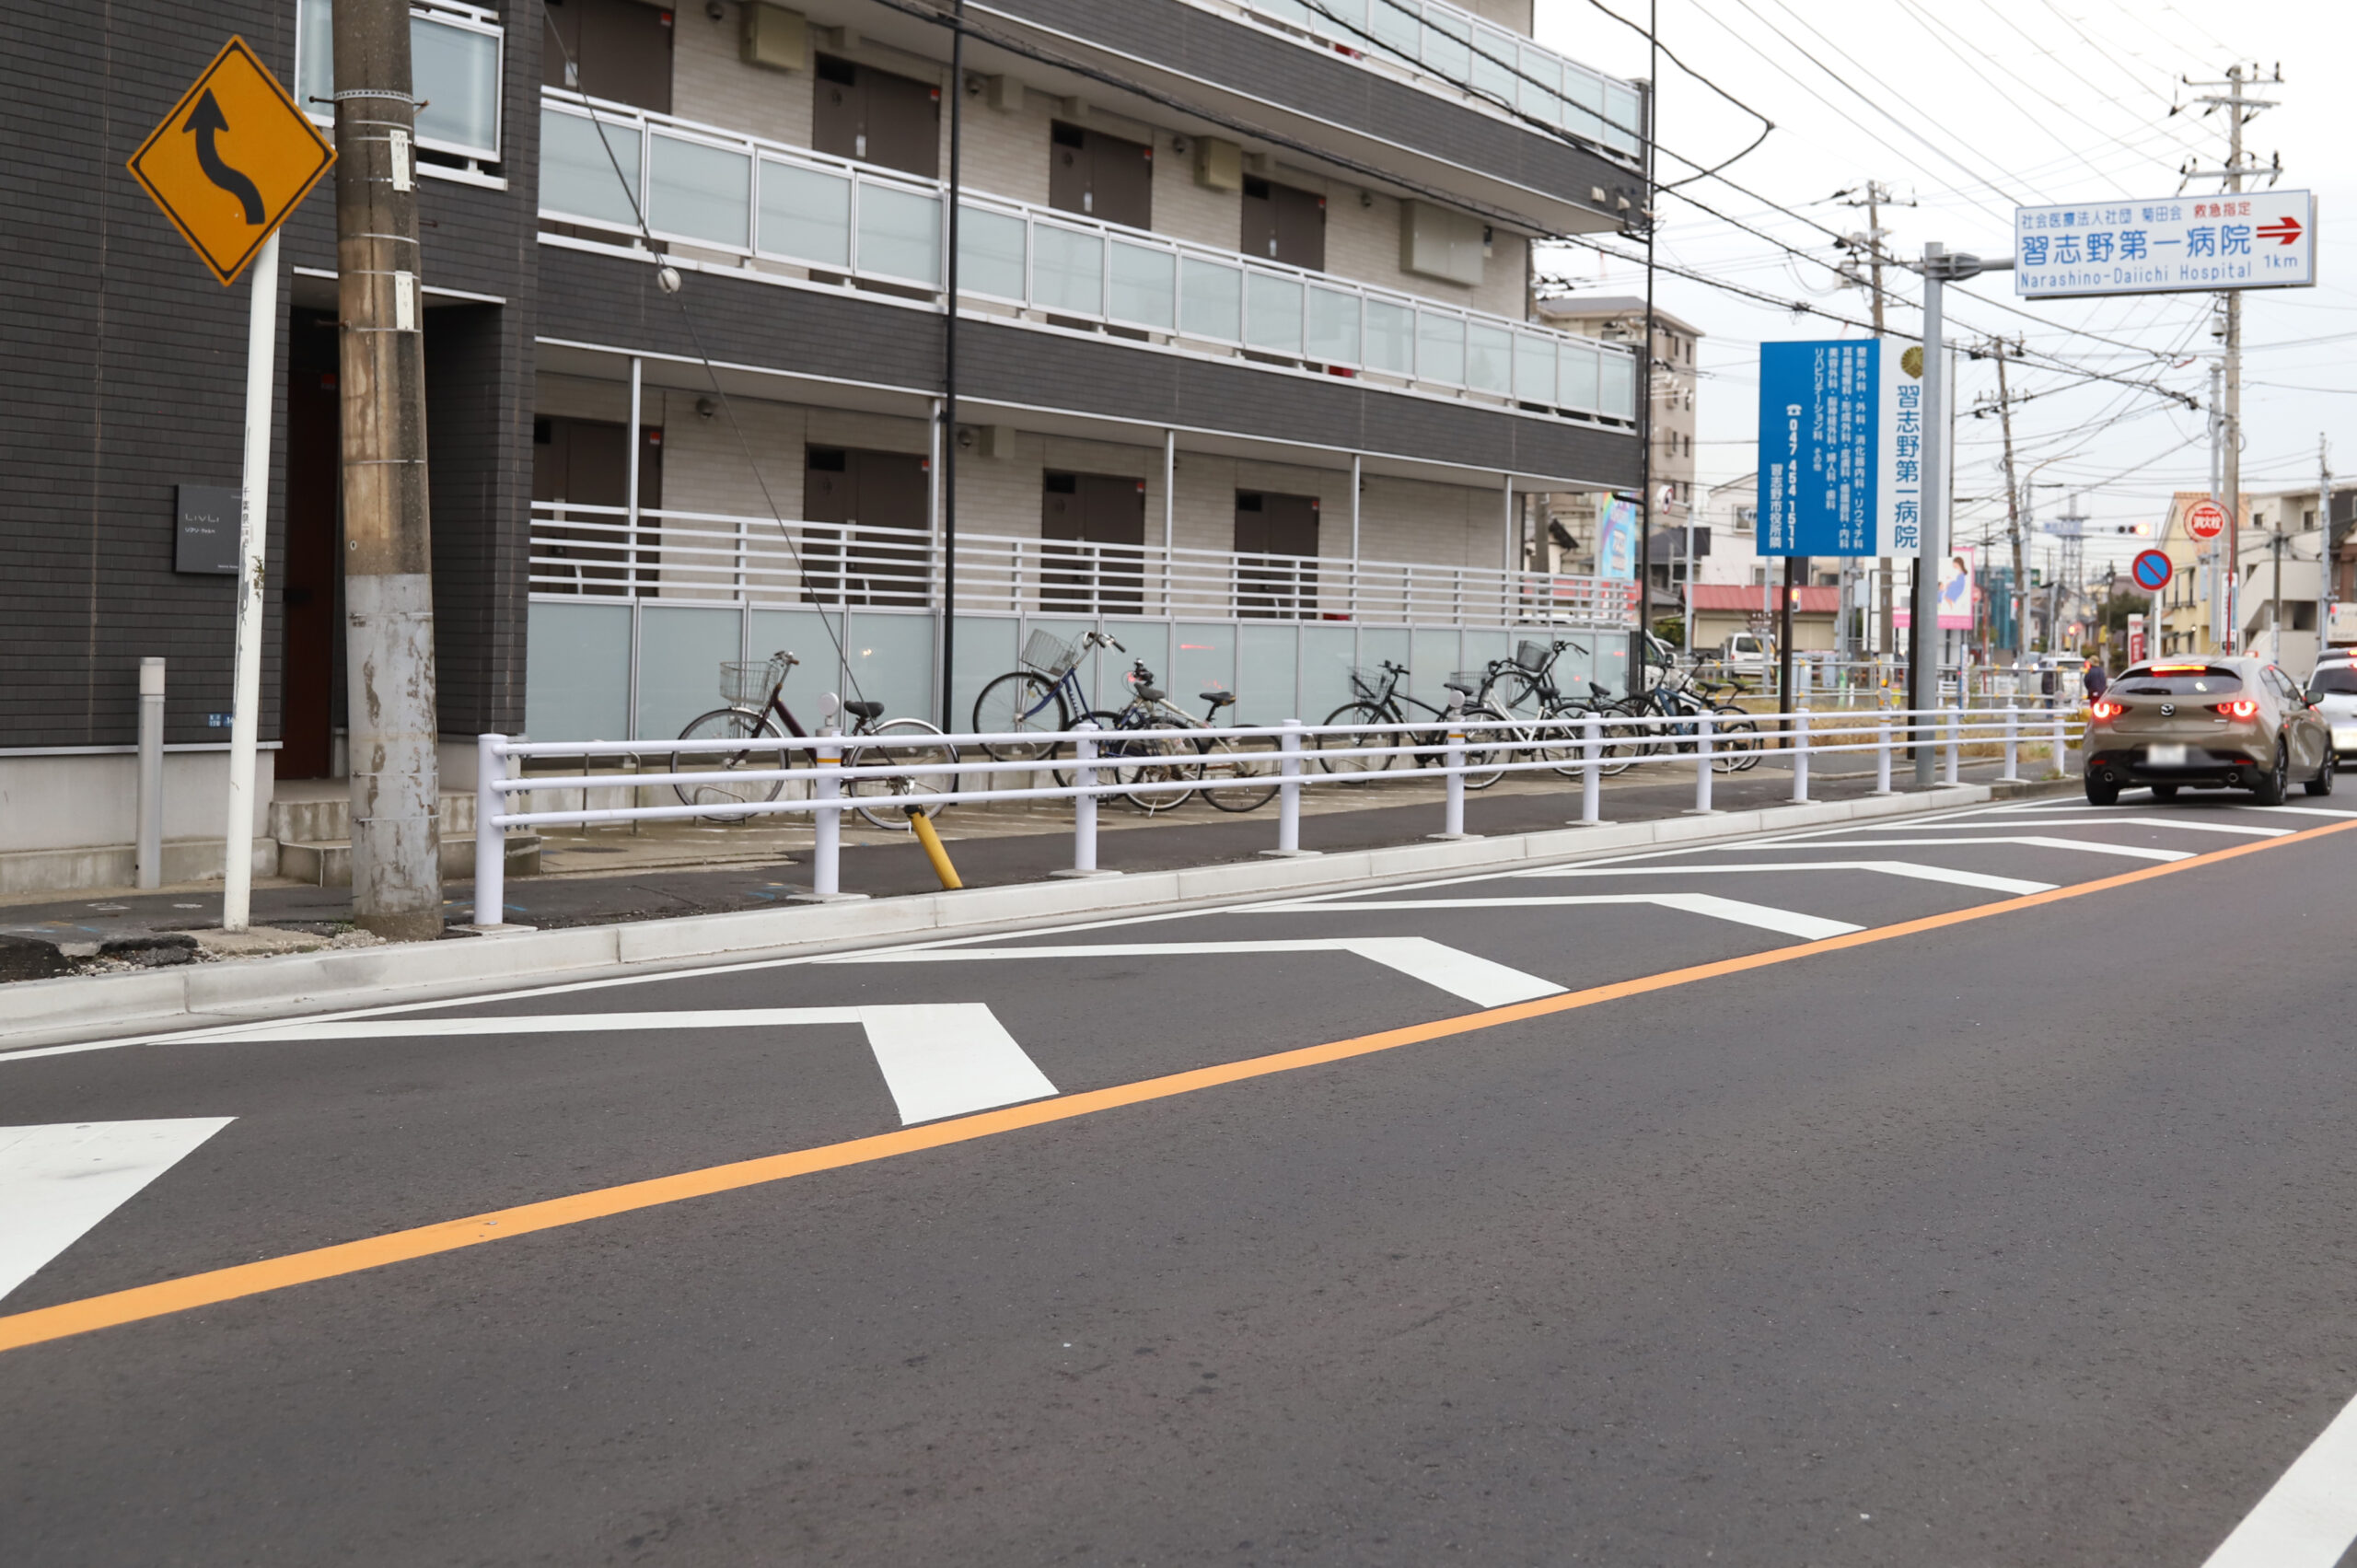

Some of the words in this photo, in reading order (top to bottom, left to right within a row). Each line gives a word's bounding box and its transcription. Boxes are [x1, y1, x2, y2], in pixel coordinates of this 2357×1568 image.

[2021, 208, 2132, 229] 社会医療法人社団
[2142, 205, 2183, 222] 菊田会
[2194, 201, 2251, 219] 救急指定
[2021, 224, 2252, 266] 習志野第一病院
[2264, 253, 2298, 269] 1km
[2021, 266, 2168, 288] Narashino-Daiichi
[2180, 261, 2251, 282] Hospital
[1788, 419, 1798, 456] 047
[1787, 459, 1798, 496] 454
[1893, 385, 1920, 549] 習志野第一病院
[1786, 500, 1797, 550] 1511
